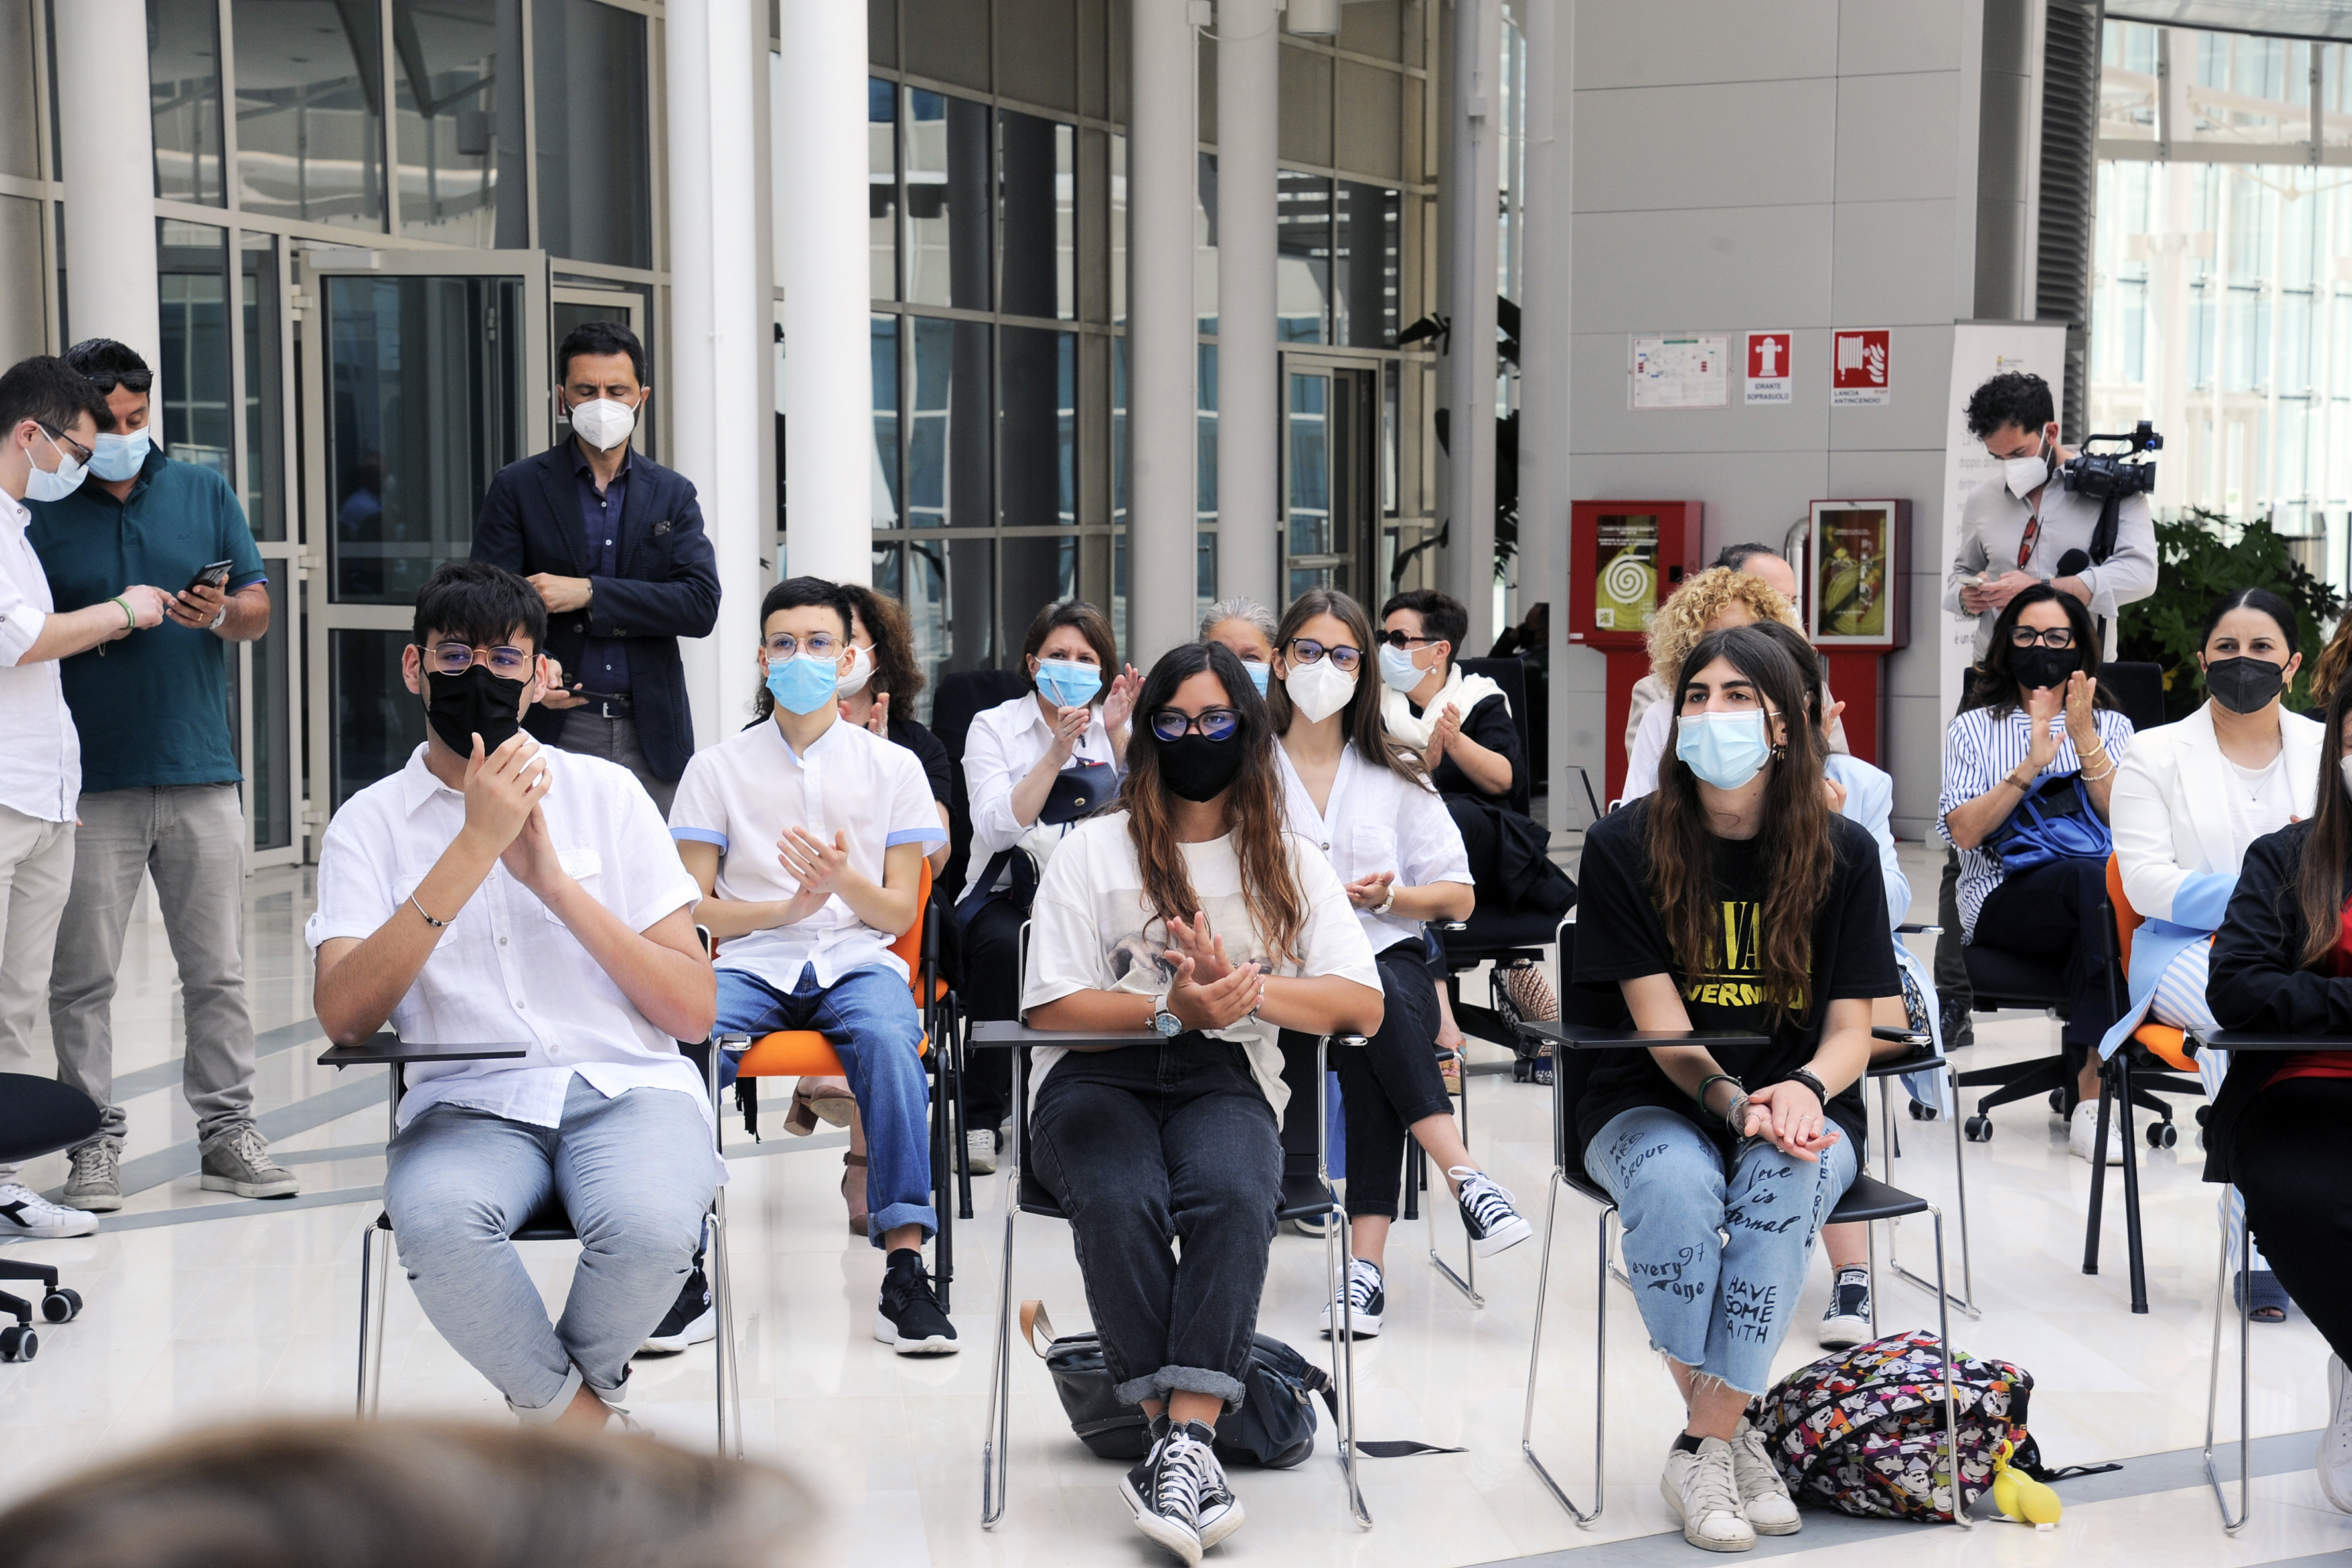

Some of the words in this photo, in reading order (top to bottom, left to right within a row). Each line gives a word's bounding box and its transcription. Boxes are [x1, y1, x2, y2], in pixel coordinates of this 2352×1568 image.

[1610, 1132, 1628, 1155] WE
[1752, 1188, 1778, 1204] is
[1725, 1206, 1801, 1234] ternal
[1678, 1242, 1705, 1266] 97
[1632, 1261, 1682, 1289] every
[1672, 1281, 1705, 1304] one
[1728, 1275, 1777, 1305] HAVE
[1725, 1294, 1774, 1324] SOME
[1726, 1319, 1768, 1344] AITH
